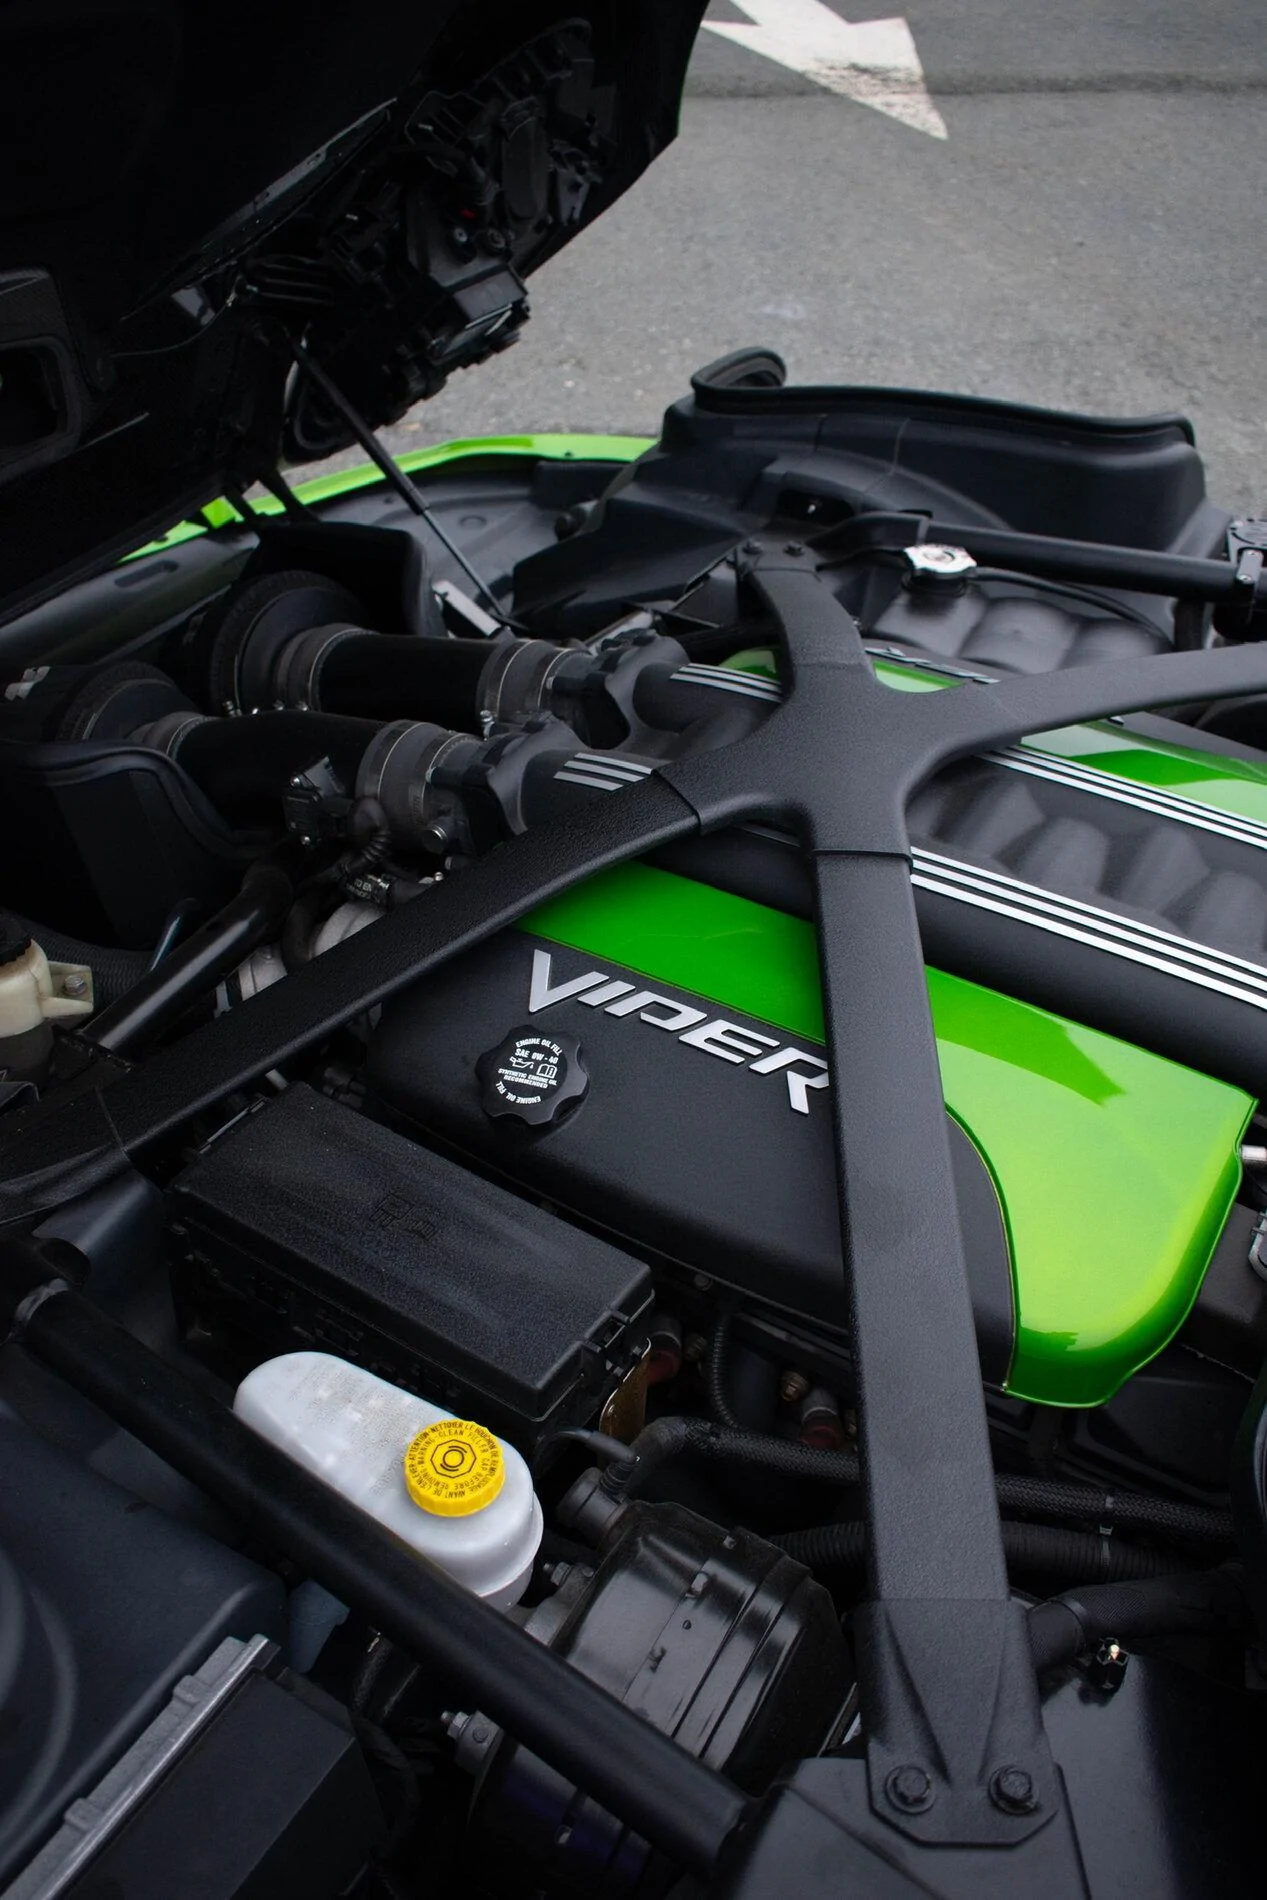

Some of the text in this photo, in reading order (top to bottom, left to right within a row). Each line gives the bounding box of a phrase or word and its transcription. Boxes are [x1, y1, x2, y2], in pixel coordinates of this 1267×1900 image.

[529, 949, 829, 1114] VIPER
[515, 1049, 530, 1058] SAE
[516, 1038, 562, 1056] ENGINE OIL FILL
[498, 1068, 527, 1078] SYNTHETIC
[528, 1074, 549, 1084] ENGINE
[503, 1075, 548, 1088] RECOMMENDED
[496, 1081, 541, 1104] ENGINE OIL FILL
[438, 1429, 464, 1437] CLEAN
